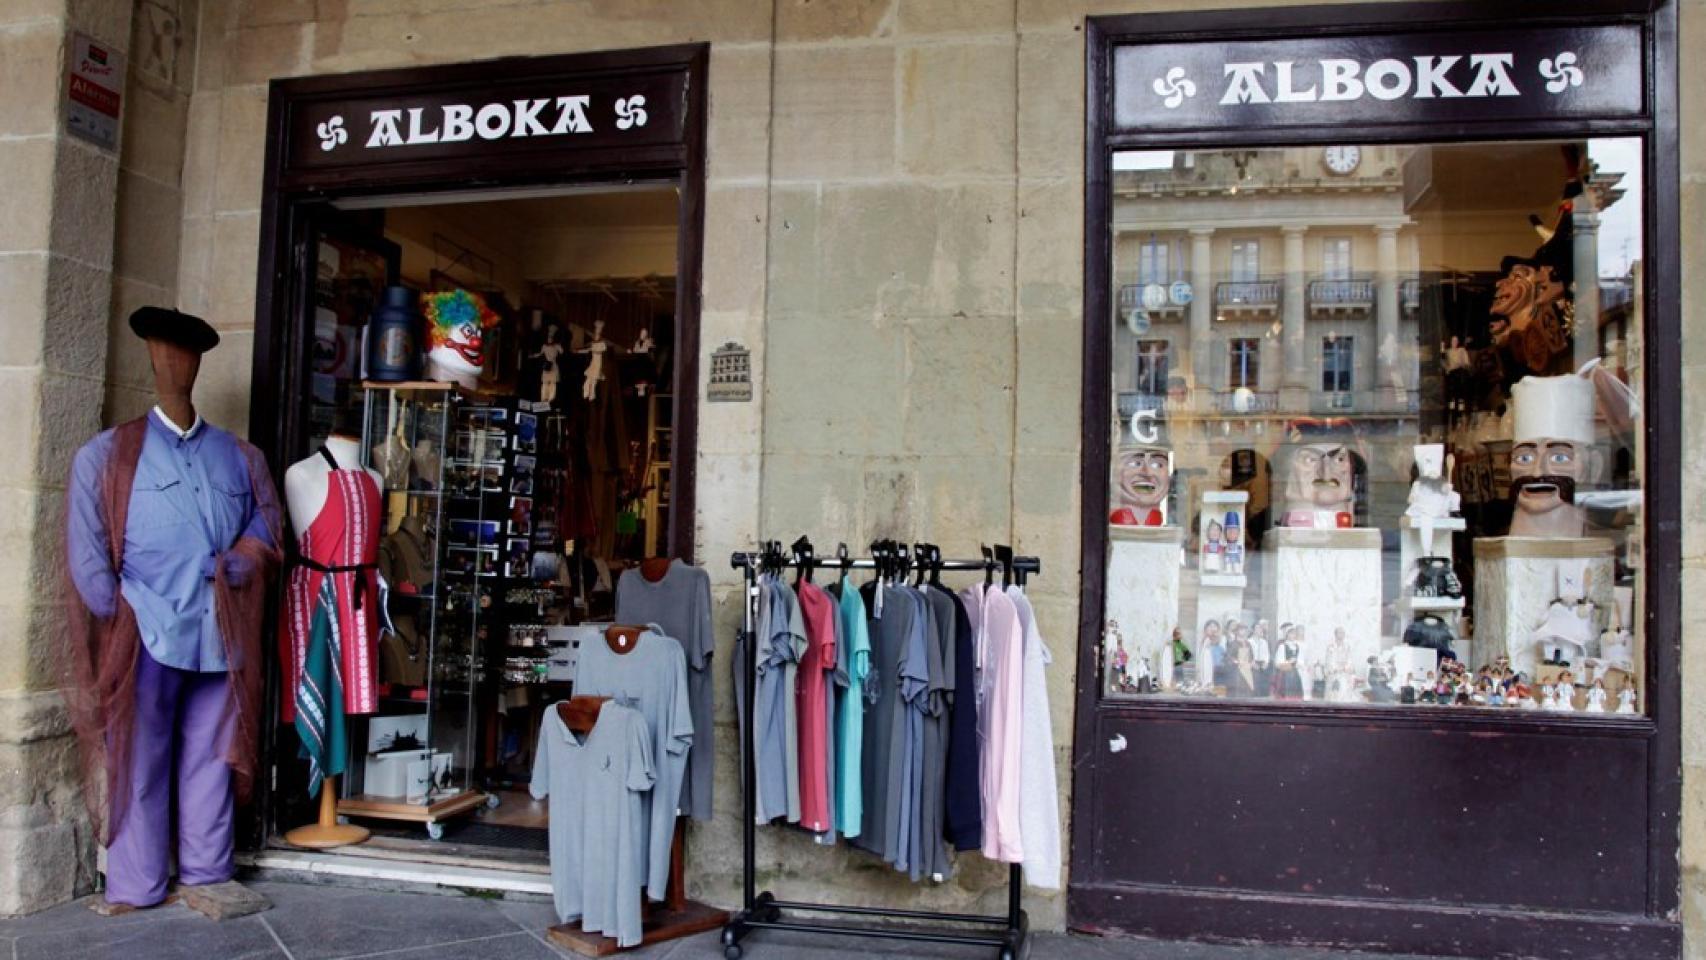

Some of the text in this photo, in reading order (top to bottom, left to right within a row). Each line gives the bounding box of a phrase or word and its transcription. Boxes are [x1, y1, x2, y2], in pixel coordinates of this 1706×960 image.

[1219, 53, 1521, 106] ALBOKA
[365, 95, 593, 148] ALBOKA
[1131, 409, 1159, 444] G
